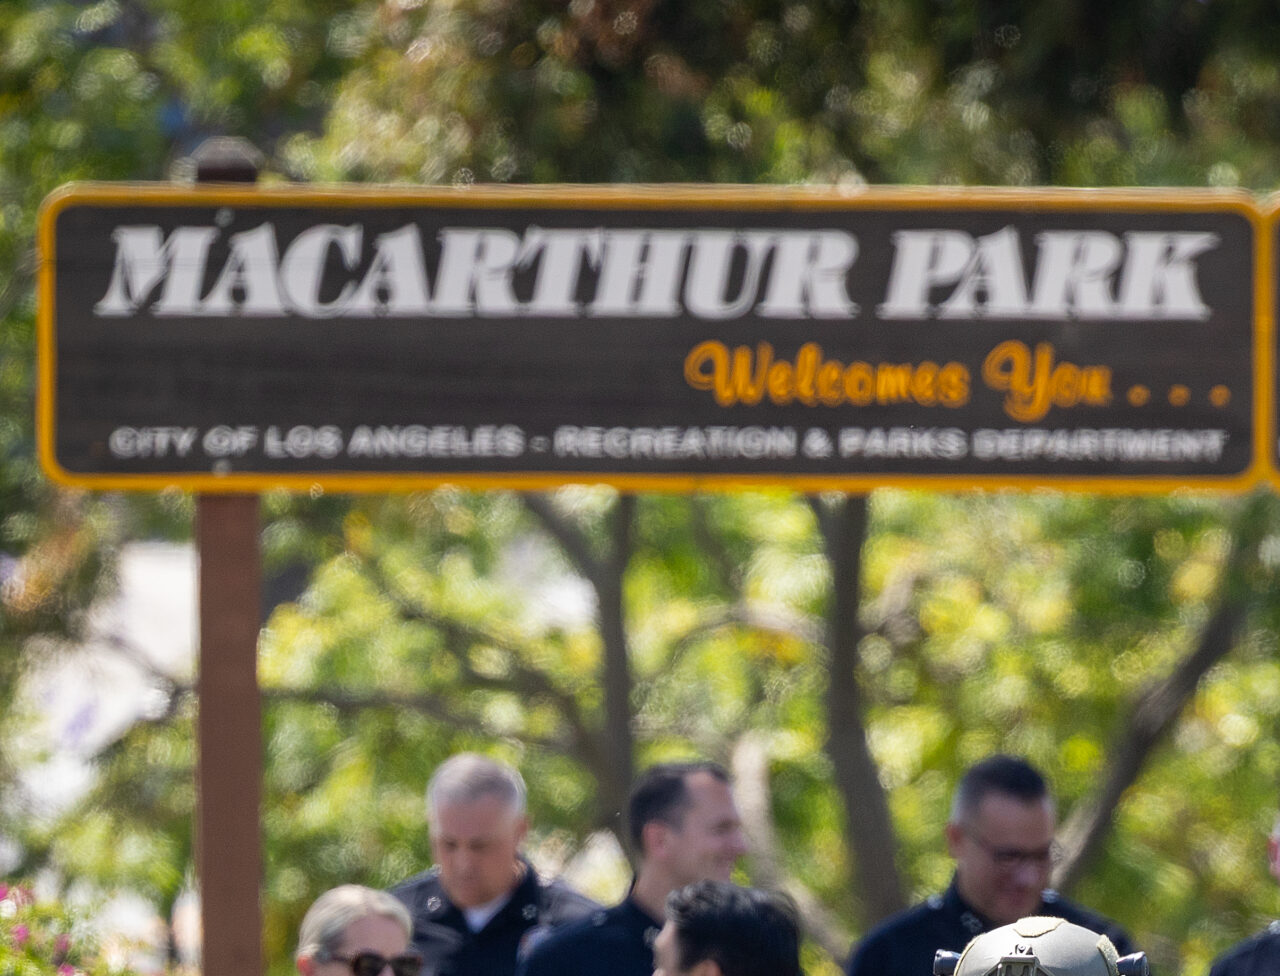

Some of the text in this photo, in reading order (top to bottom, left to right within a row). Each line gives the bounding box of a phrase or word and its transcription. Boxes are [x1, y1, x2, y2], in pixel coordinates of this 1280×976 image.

[95, 223, 1220, 321] MACARTHUR PARK
[684, 340, 971, 407] Welcomes
[109, 426, 197, 458] CITY
[203, 425, 259, 458] OF
[264, 425, 343, 459] LOS
[347, 425, 526, 459] ANGELES
[554, 426, 797, 459] RECREATION
[802, 427, 834, 459] &
[838, 427, 968, 459] PARKS
[973, 428, 1227, 461] DEPARTMENT
